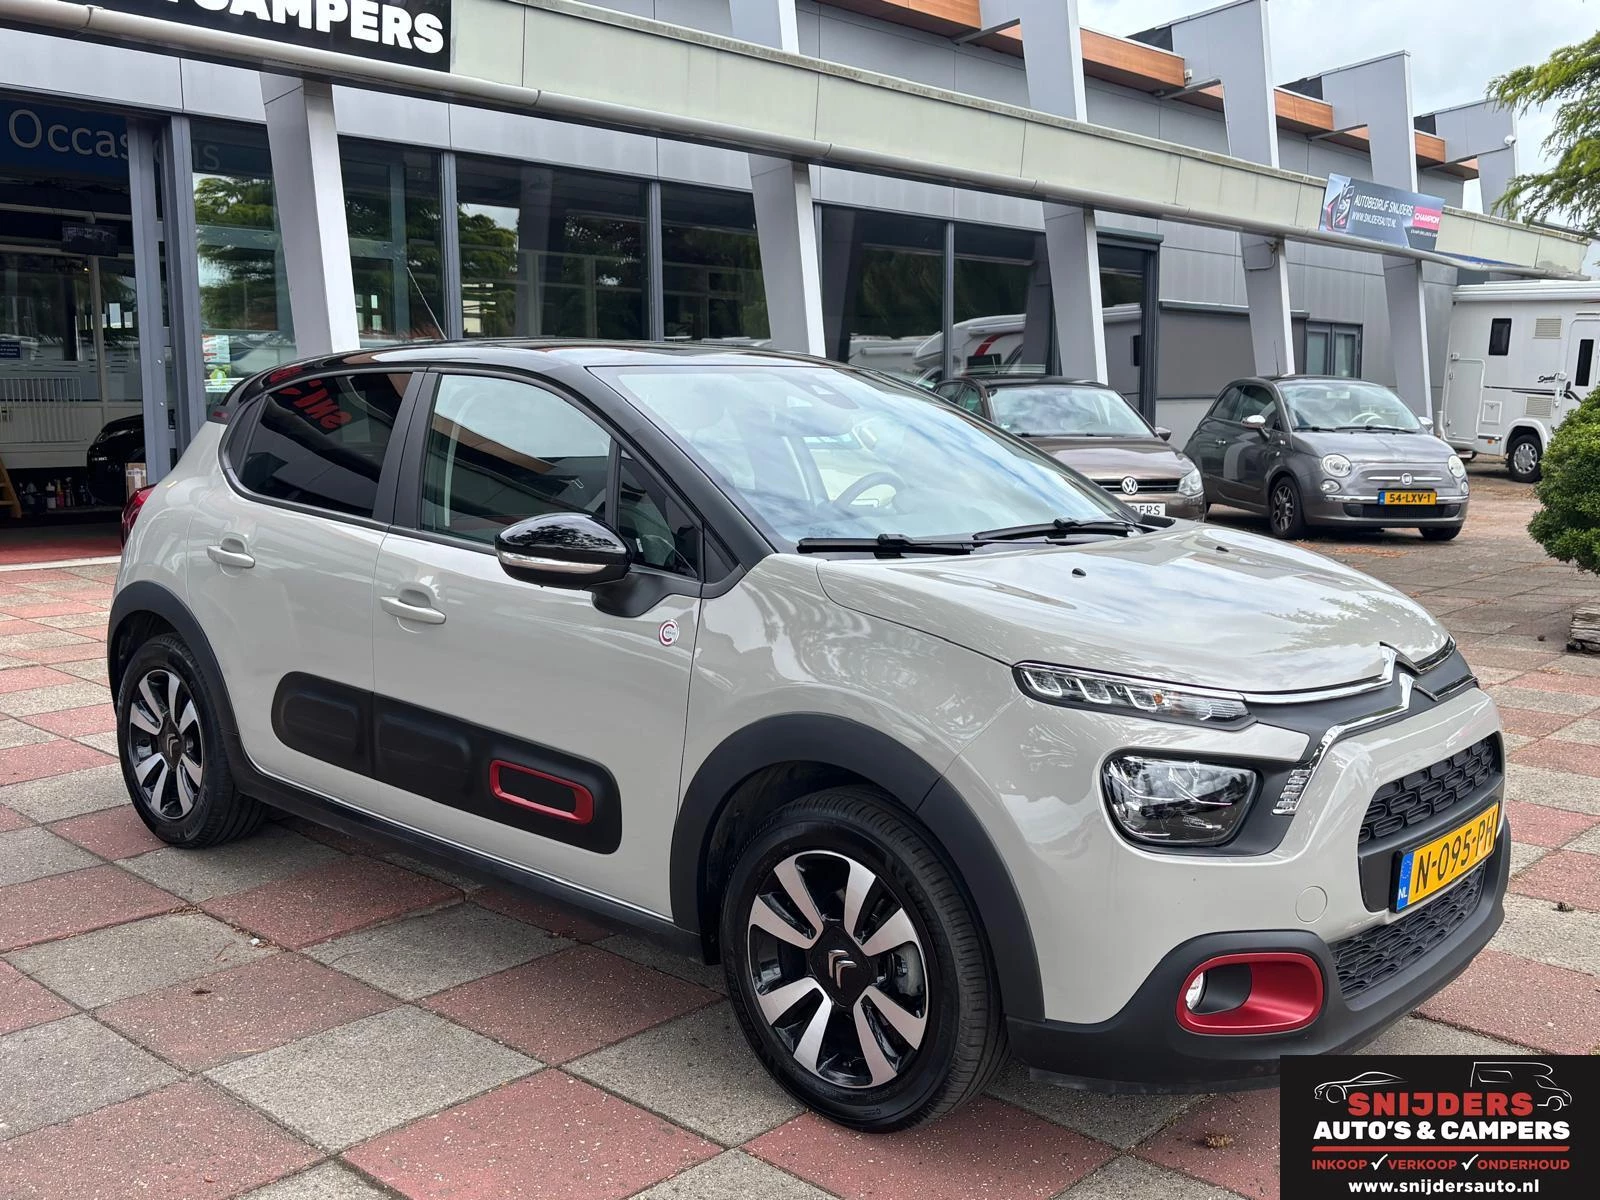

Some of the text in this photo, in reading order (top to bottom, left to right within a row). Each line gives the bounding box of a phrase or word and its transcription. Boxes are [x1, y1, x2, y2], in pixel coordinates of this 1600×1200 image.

[195, 0, 444, 54] MPERS
[1388, 201, 1414, 216] SNIJDERS
[1414, 212, 1440, 224] CHAMPION
[1389, 493, 1431, 503] 54-LXV-1
[1415, 811, 1496, 894] N-095-PH
[1398, 886, 1408, 900] NL
